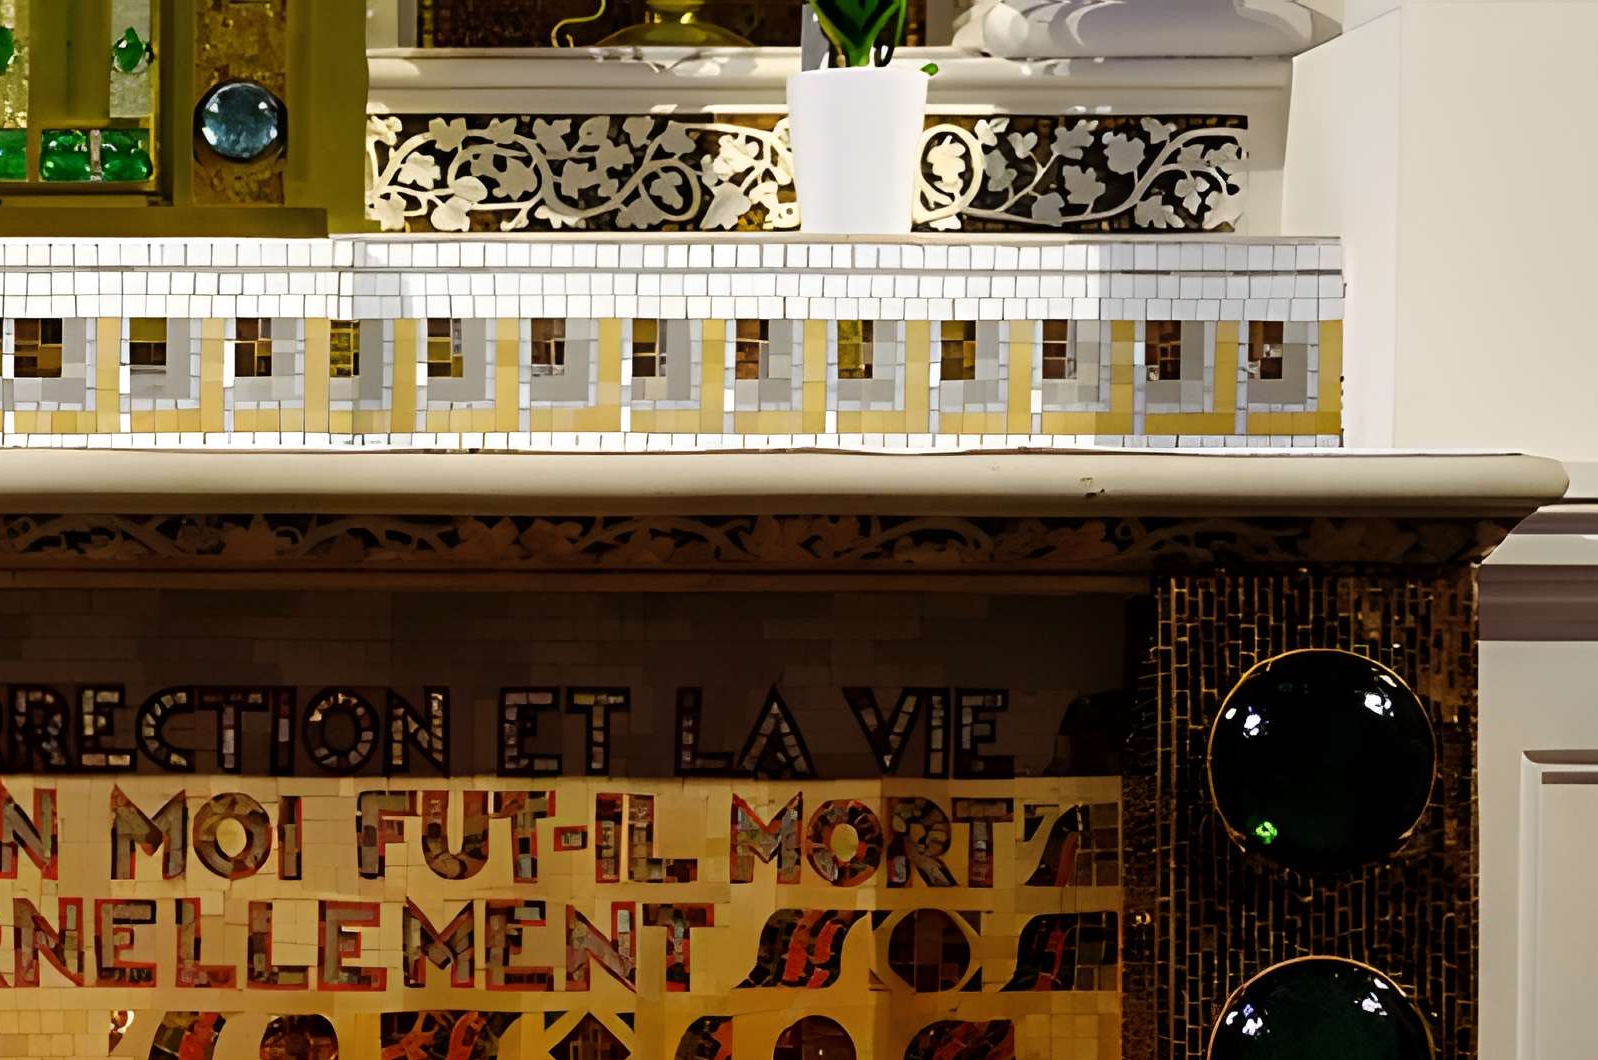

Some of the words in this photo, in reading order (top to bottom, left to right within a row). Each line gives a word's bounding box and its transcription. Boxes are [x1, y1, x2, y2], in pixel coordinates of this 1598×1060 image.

[497, 686, 631, 777] ET
[675, 684, 817, 778] LA
[843, 687, 1014, 778] VIE
[111, 785, 302, 880] MOI
[357, 790, 698, 883] FUT-IL
[731, 790, 1013, 887] MORT
